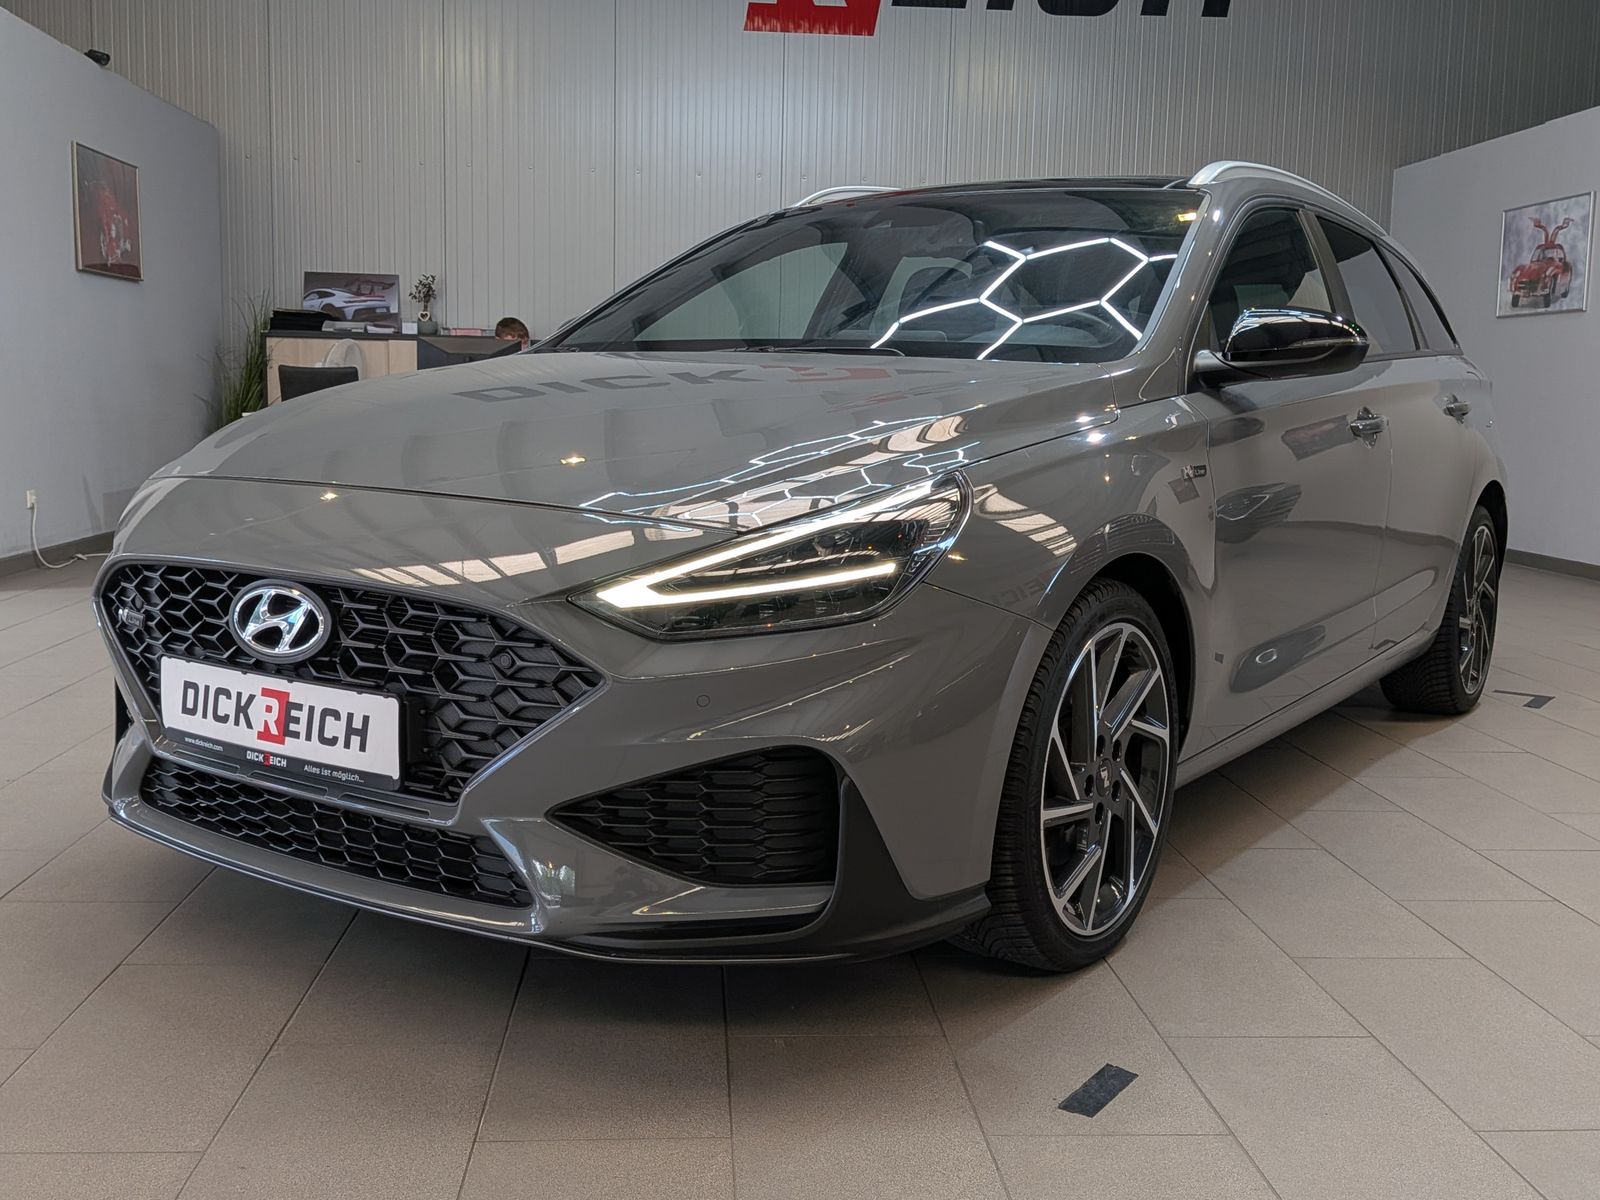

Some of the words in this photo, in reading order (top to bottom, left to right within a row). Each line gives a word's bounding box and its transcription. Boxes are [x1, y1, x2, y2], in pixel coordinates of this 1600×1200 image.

[181, 680, 370, 753] DICKREICH
[303, 764, 320, 774] Alles
[321, 767, 331, 776] ist
